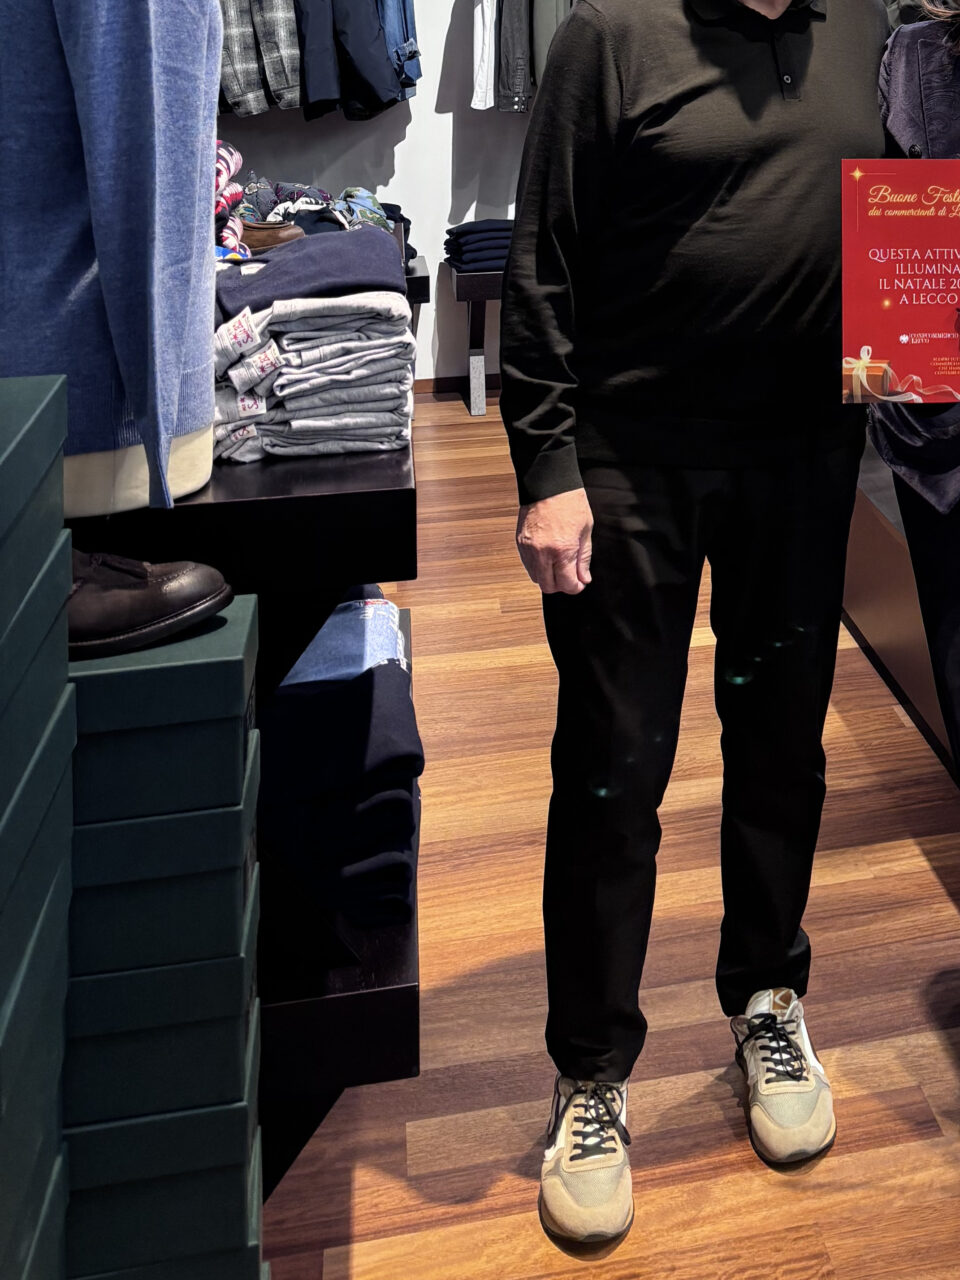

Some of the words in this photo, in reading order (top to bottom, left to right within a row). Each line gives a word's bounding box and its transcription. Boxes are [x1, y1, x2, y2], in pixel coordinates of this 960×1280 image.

[868, 185, 918, 203] Buone
[868, 206, 882, 216] dai
[885, 206, 936, 216] commercianti
[937, 206, 947, 216] di
[868, 248, 921, 263] QUESTA
[879, 278, 891, 289] IL
[894, 278, 946, 289] NATALE
[899, 293, 909, 304] A
[912, 293, 958, 304] LECCO
